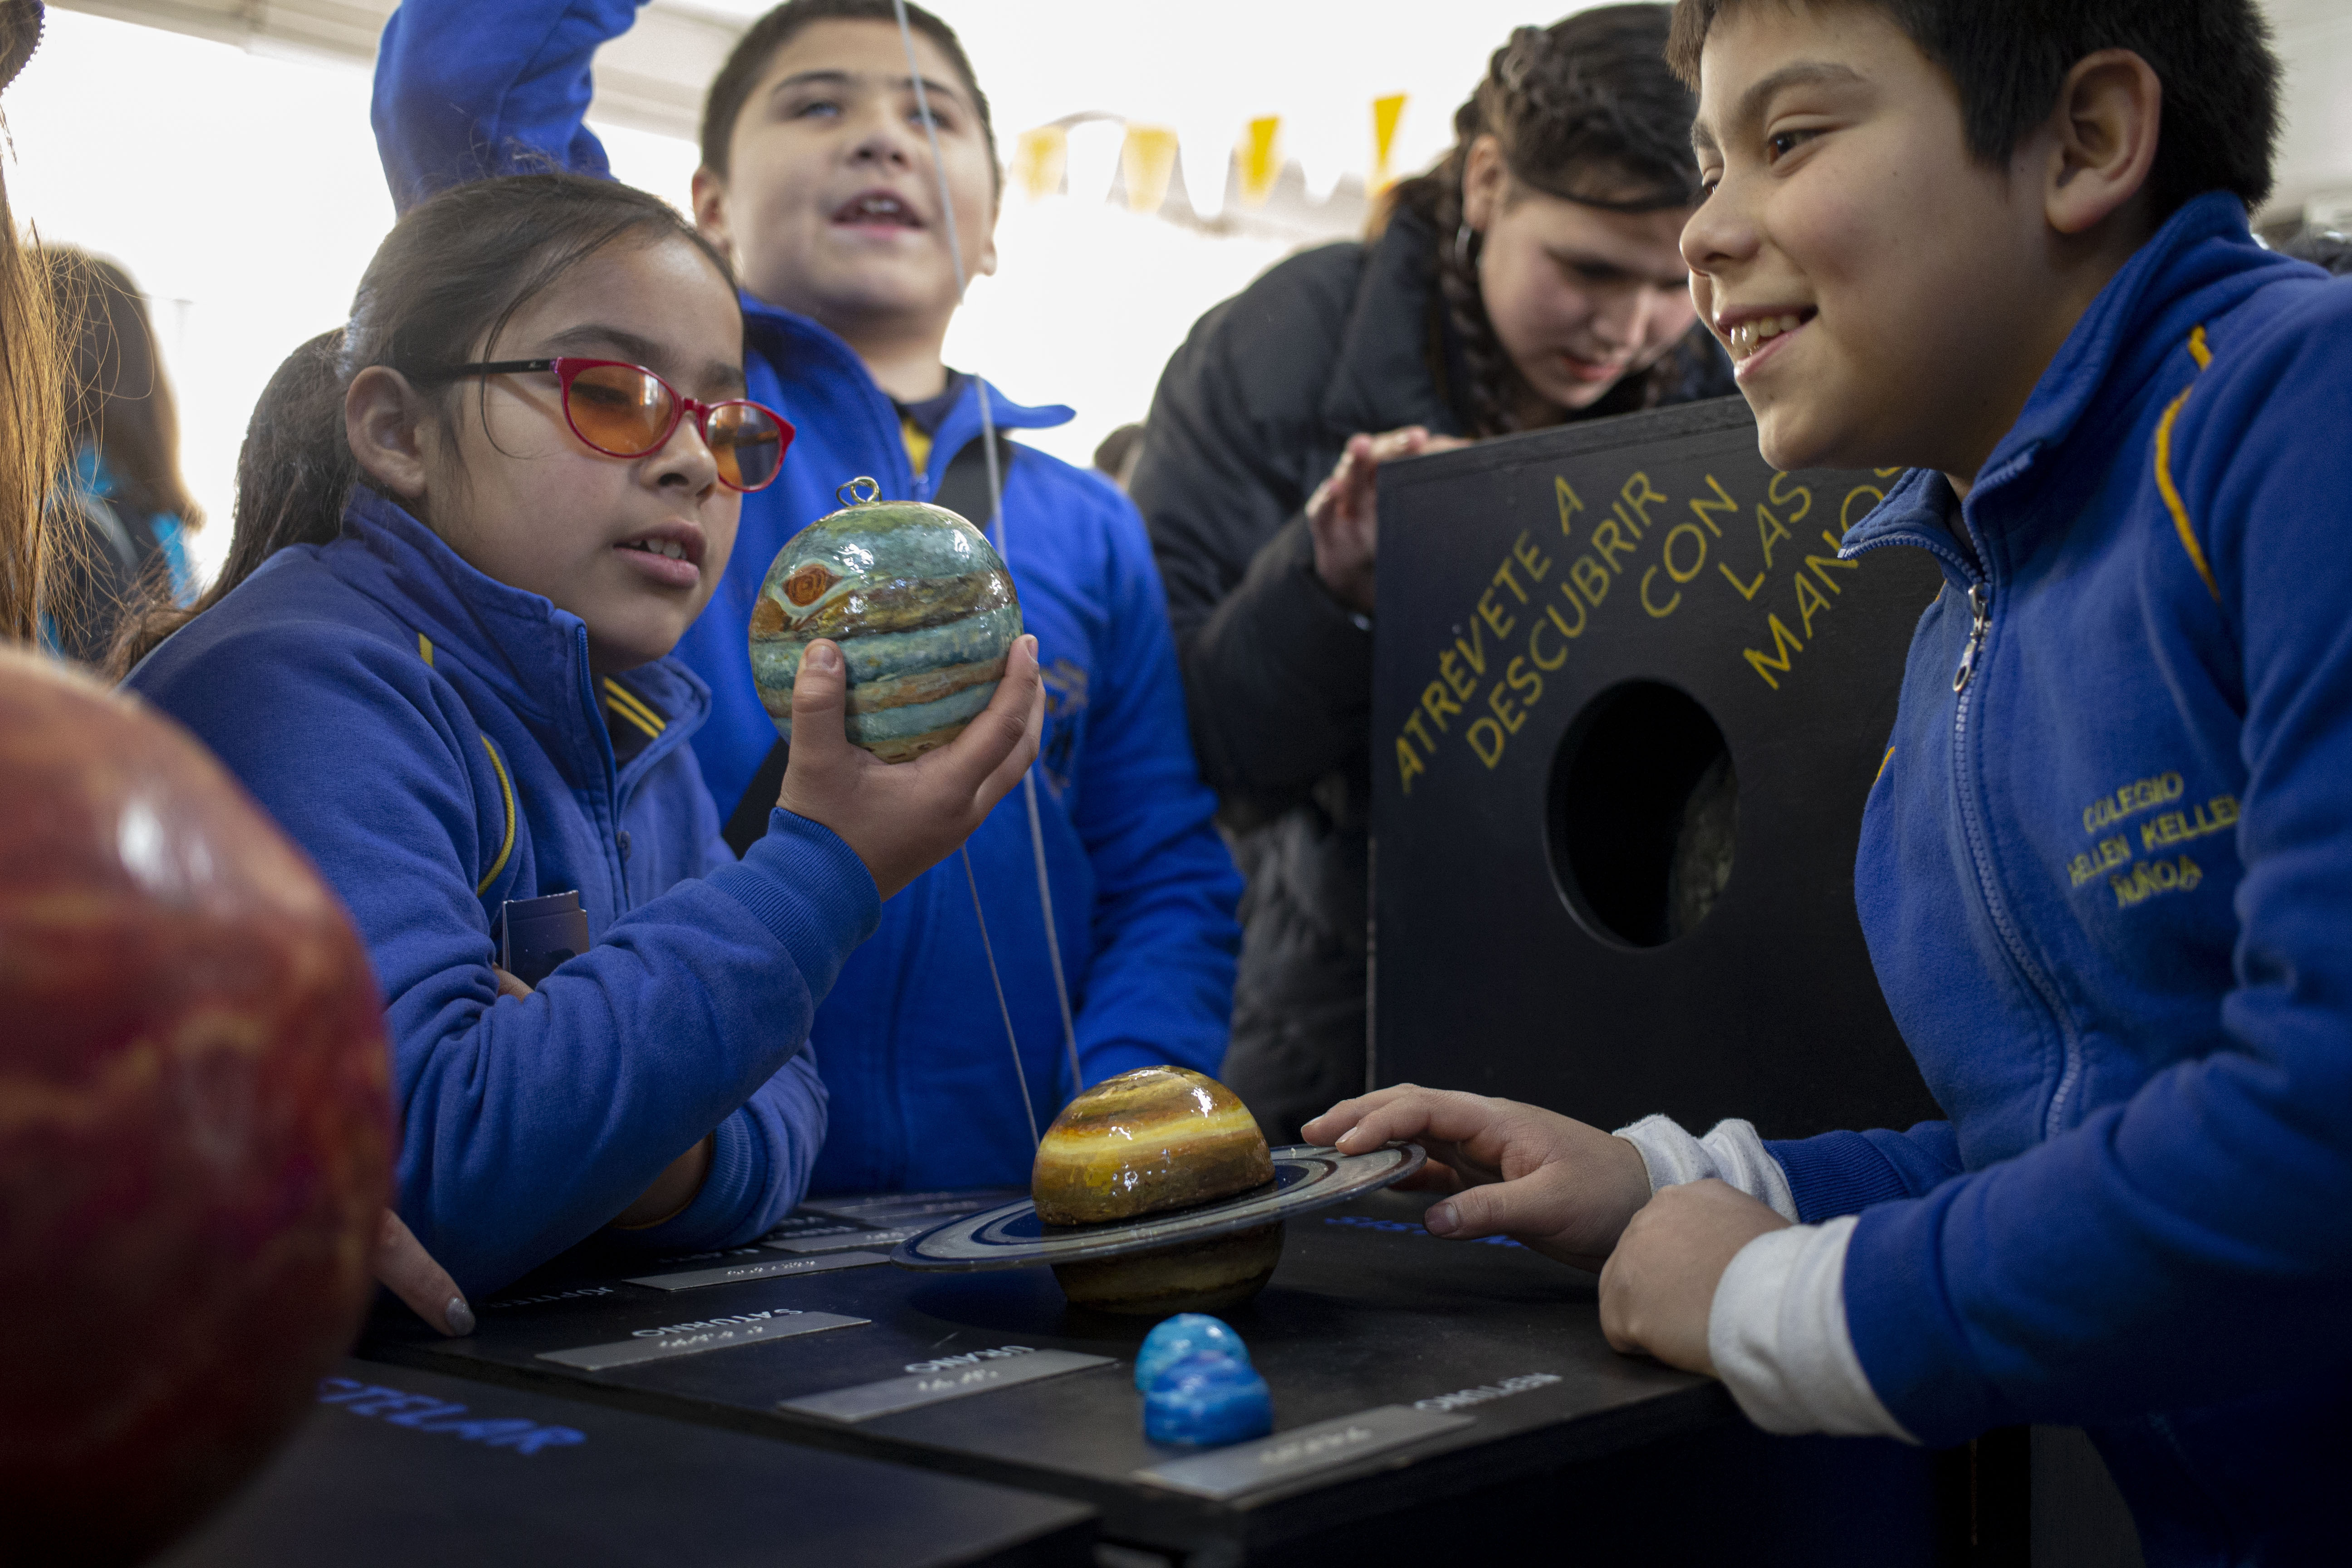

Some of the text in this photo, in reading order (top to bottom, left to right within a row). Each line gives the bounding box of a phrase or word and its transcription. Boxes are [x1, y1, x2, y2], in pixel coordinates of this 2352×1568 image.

[1639, 473, 1739, 618] CON
[1718, 470, 1812, 601] LAS
[1742, 467, 1901, 690] MANO
[1395, 475, 1584, 794] ATRÉVETE A
[1466, 470, 1668, 769] DESCUBRIR
[2082, 771, 2184, 834] COLEGIO
[632, 1308, 804, 1338] SATURNO
